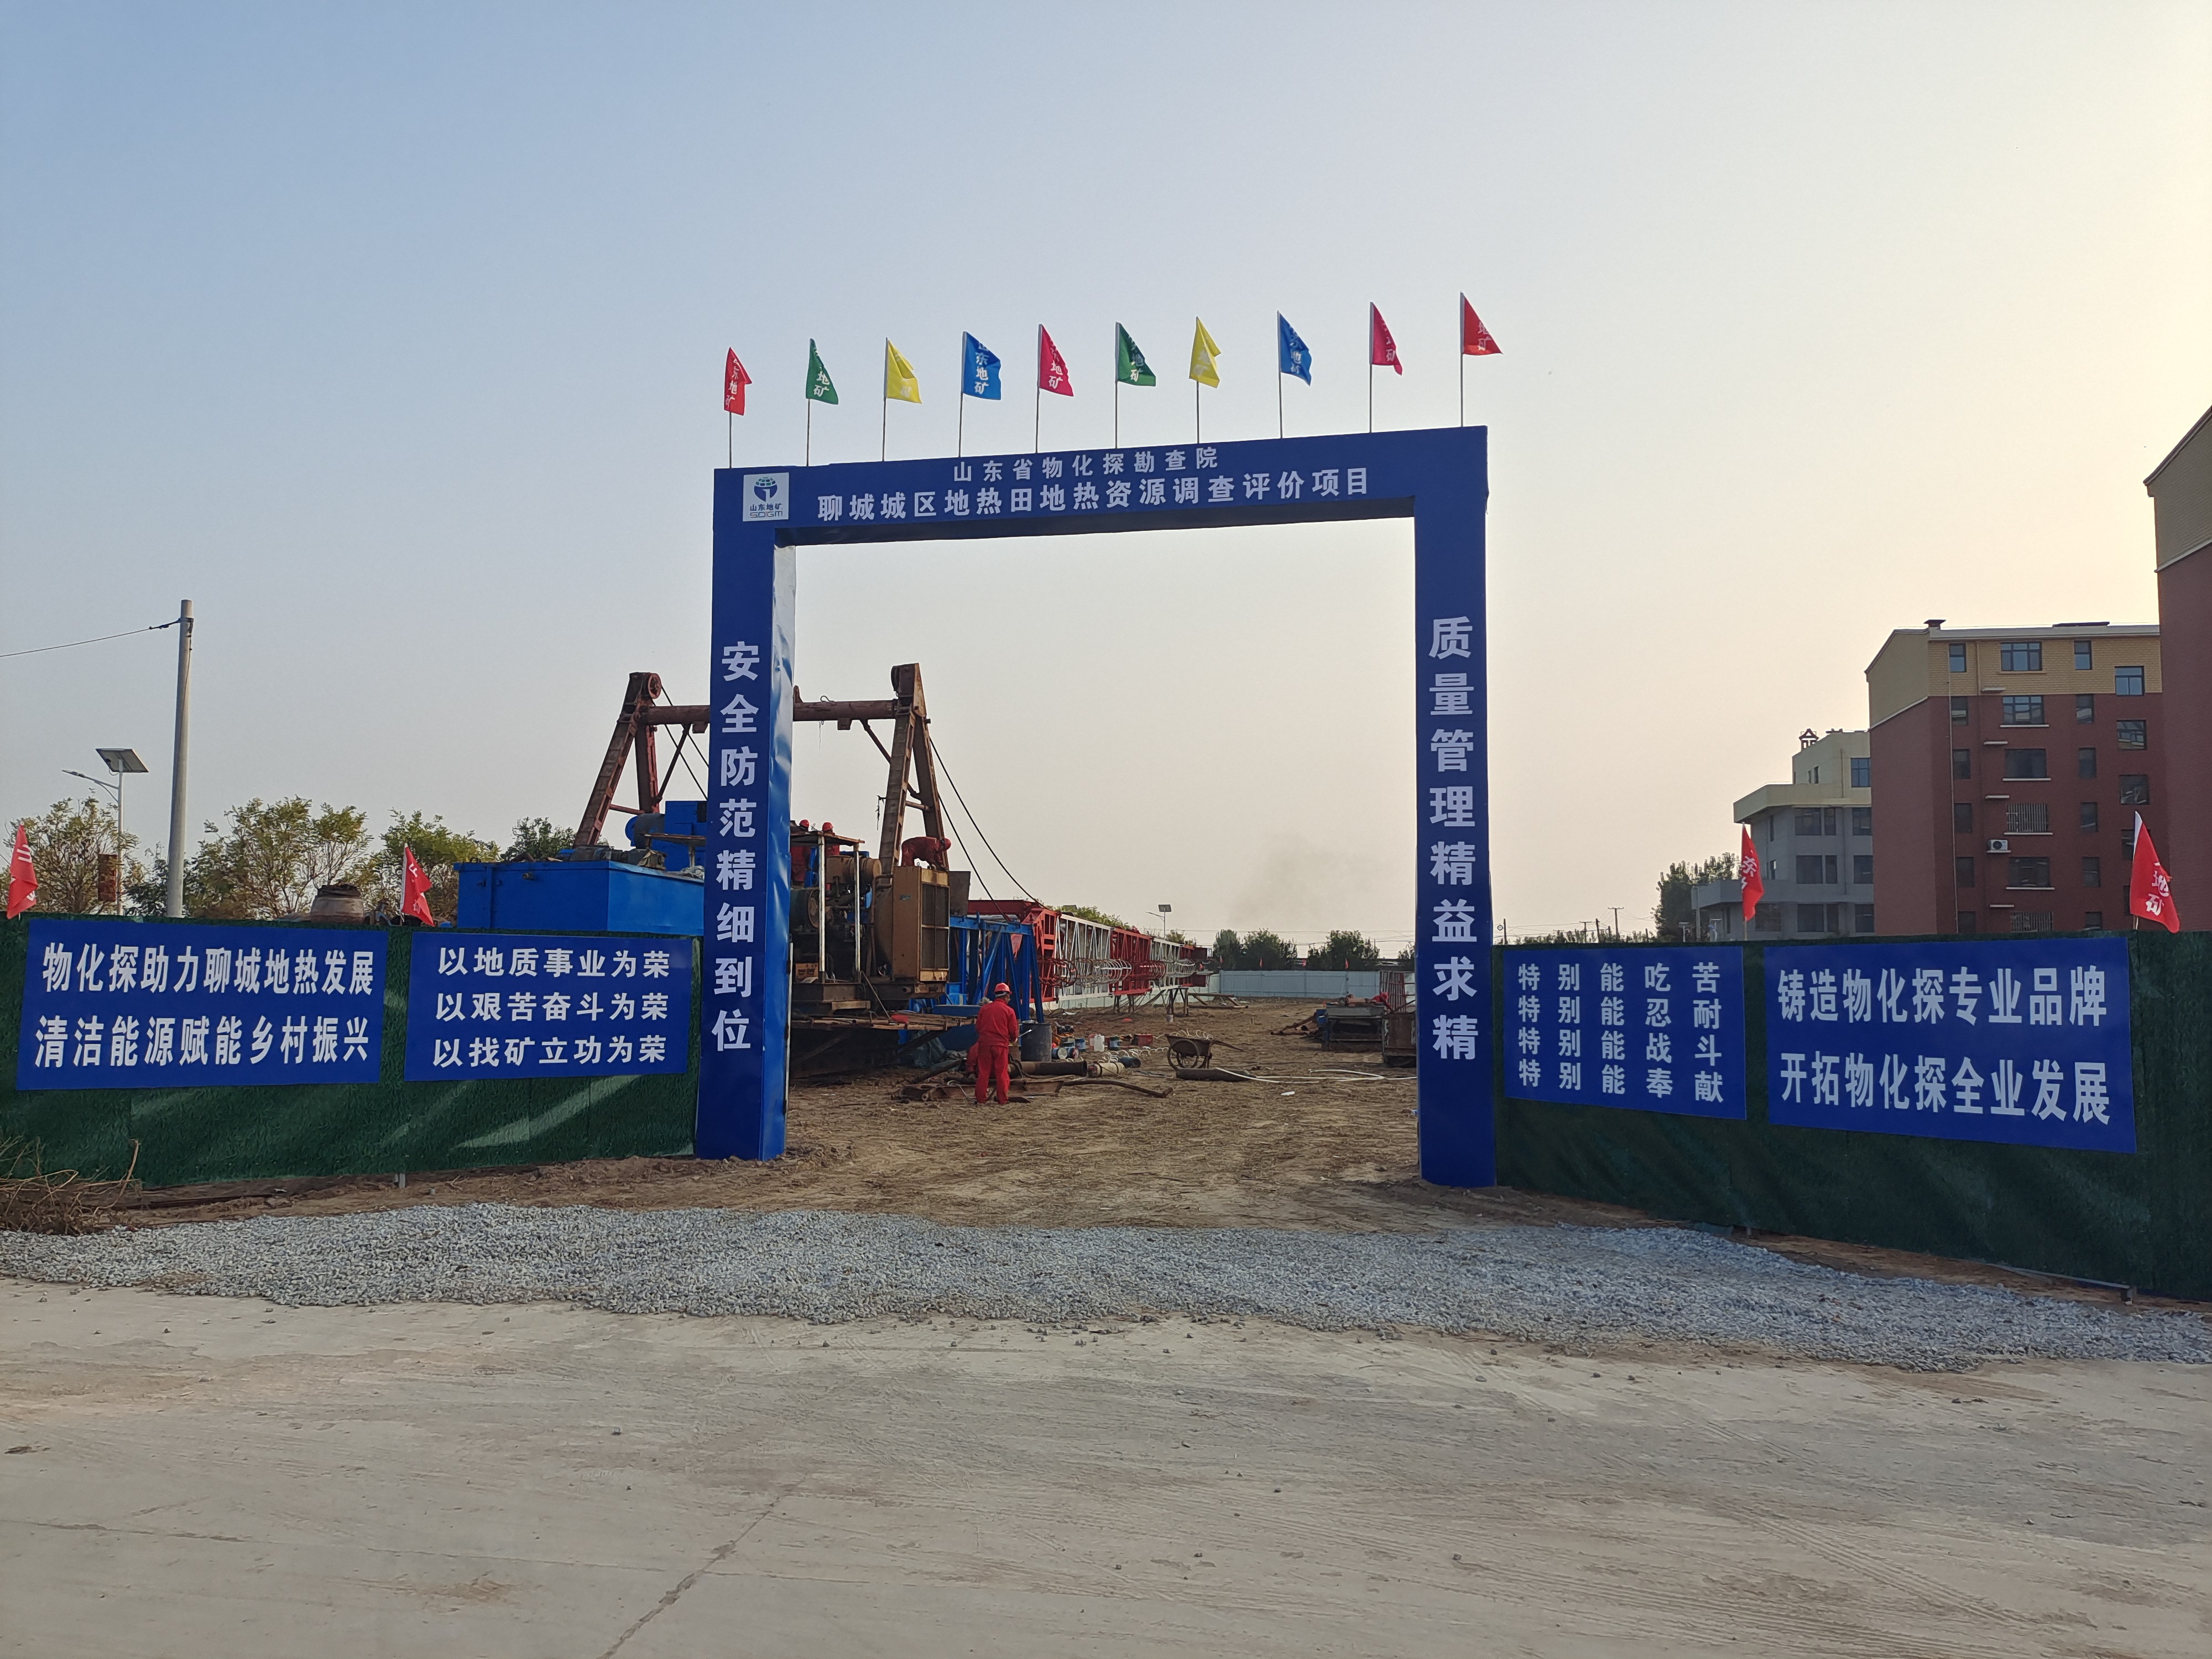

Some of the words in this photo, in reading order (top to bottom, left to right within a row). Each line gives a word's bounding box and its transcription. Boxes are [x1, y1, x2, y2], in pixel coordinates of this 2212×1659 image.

[954, 446, 1218, 482] 山东省物化探勘查院
[750, 503, 782, 511] 山东地矿
[818, 467, 1368, 521] 聊城城区地热田地热资源调查评价项目
[712, 641, 760, 1051] 安全防范精细到位
[1428, 616, 1478, 1060] 质量管理精益求精
[42, 942, 373, 995] 物化探助力聊城地热发展
[438, 947, 670, 978] 以地质事业为荣
[1518, 962, 1720, 993] 特别能吃苦
[436, 992, 669, 1022] 以艰苦奋斗为荣
[1518, 995, 1721, 1029] 特别能忍耐
[1777, 966, 2107, 1026] 铸造物化探专业品牌
[35, 1015, 369, 1068] 清洁能源赋能乡村振兴
[432, 1035, 666, 1068] 以找矿立功为荣
[1518, 1027, 1722, 1066] 特别能战斗
[1518, 1059, 1724, 1103] 特别能奉献
[1781, 1051, 2110, 1125] 开拓物化探全业发展
